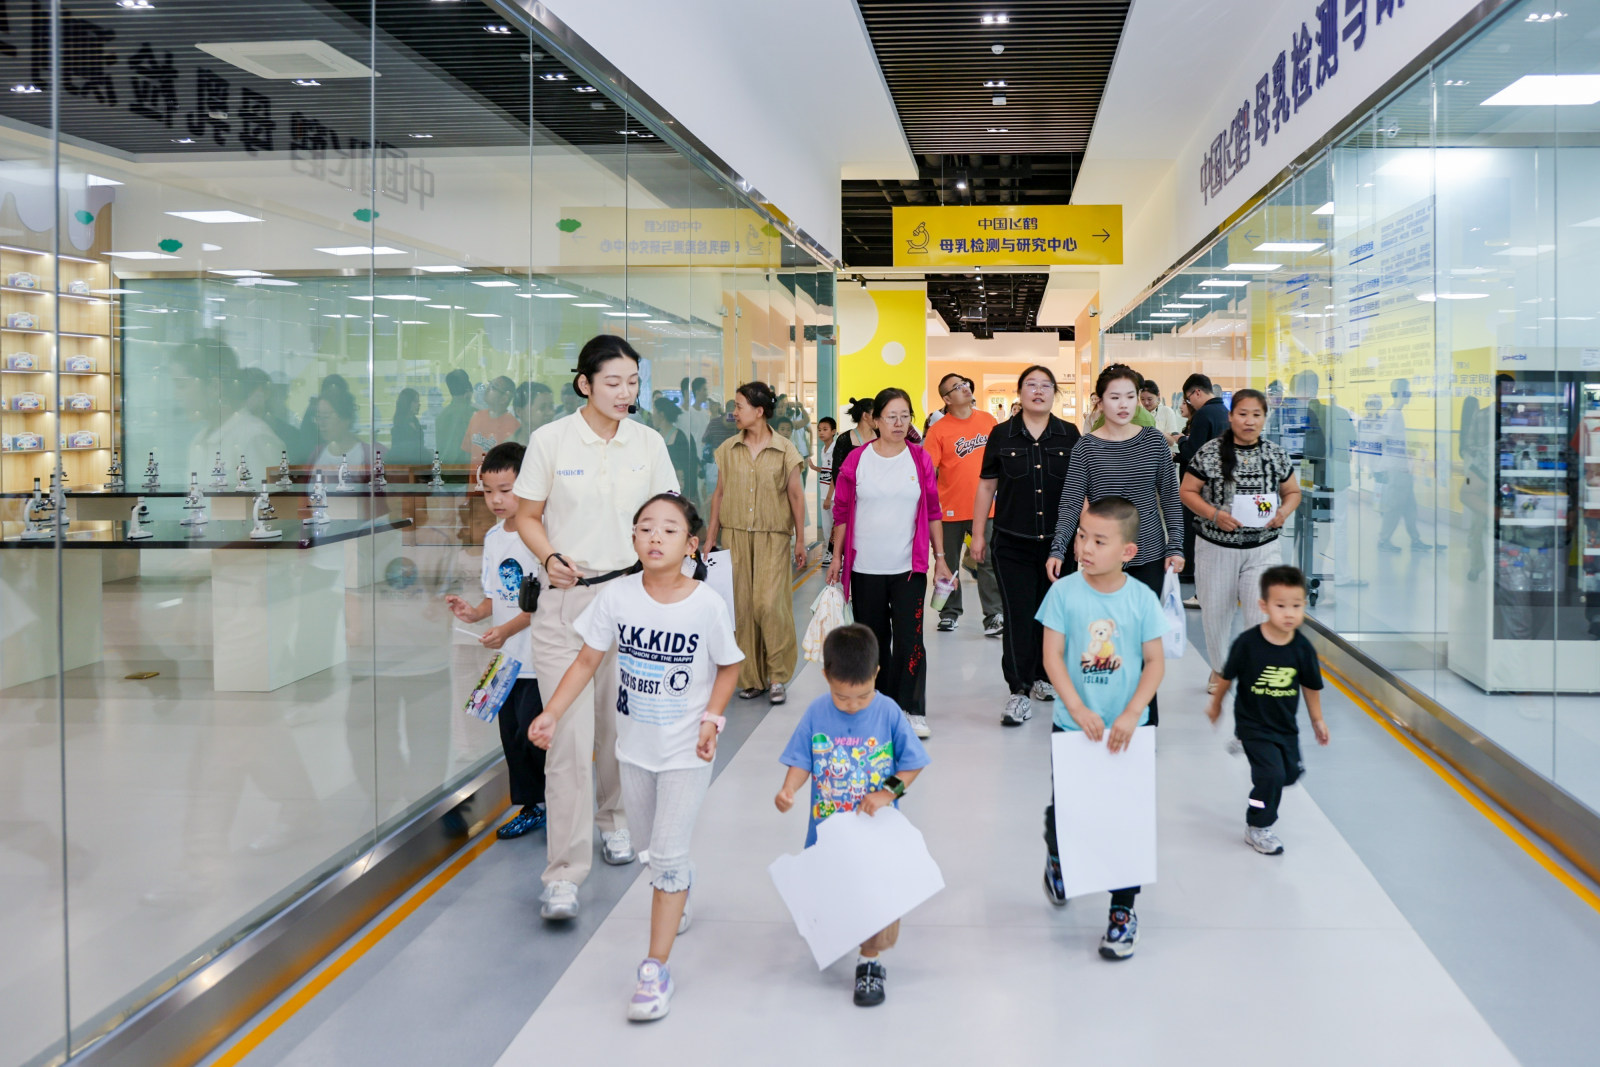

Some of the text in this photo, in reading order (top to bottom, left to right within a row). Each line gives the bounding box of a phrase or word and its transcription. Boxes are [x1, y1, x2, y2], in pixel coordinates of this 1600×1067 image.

[1200, 99, 1250, 206] 中国飞鹤
[978, 217, 1038, 231] 中国飞鹤
[939, 237, 1078, 254] 母乳检测与研究中心
[954, 433, 988, 458] Eagles
[1080, 657, 1120, 674] Teddy
[637, 678, 662, 695] BEST.
[1083, 675, 1109, 685] ISLAND
